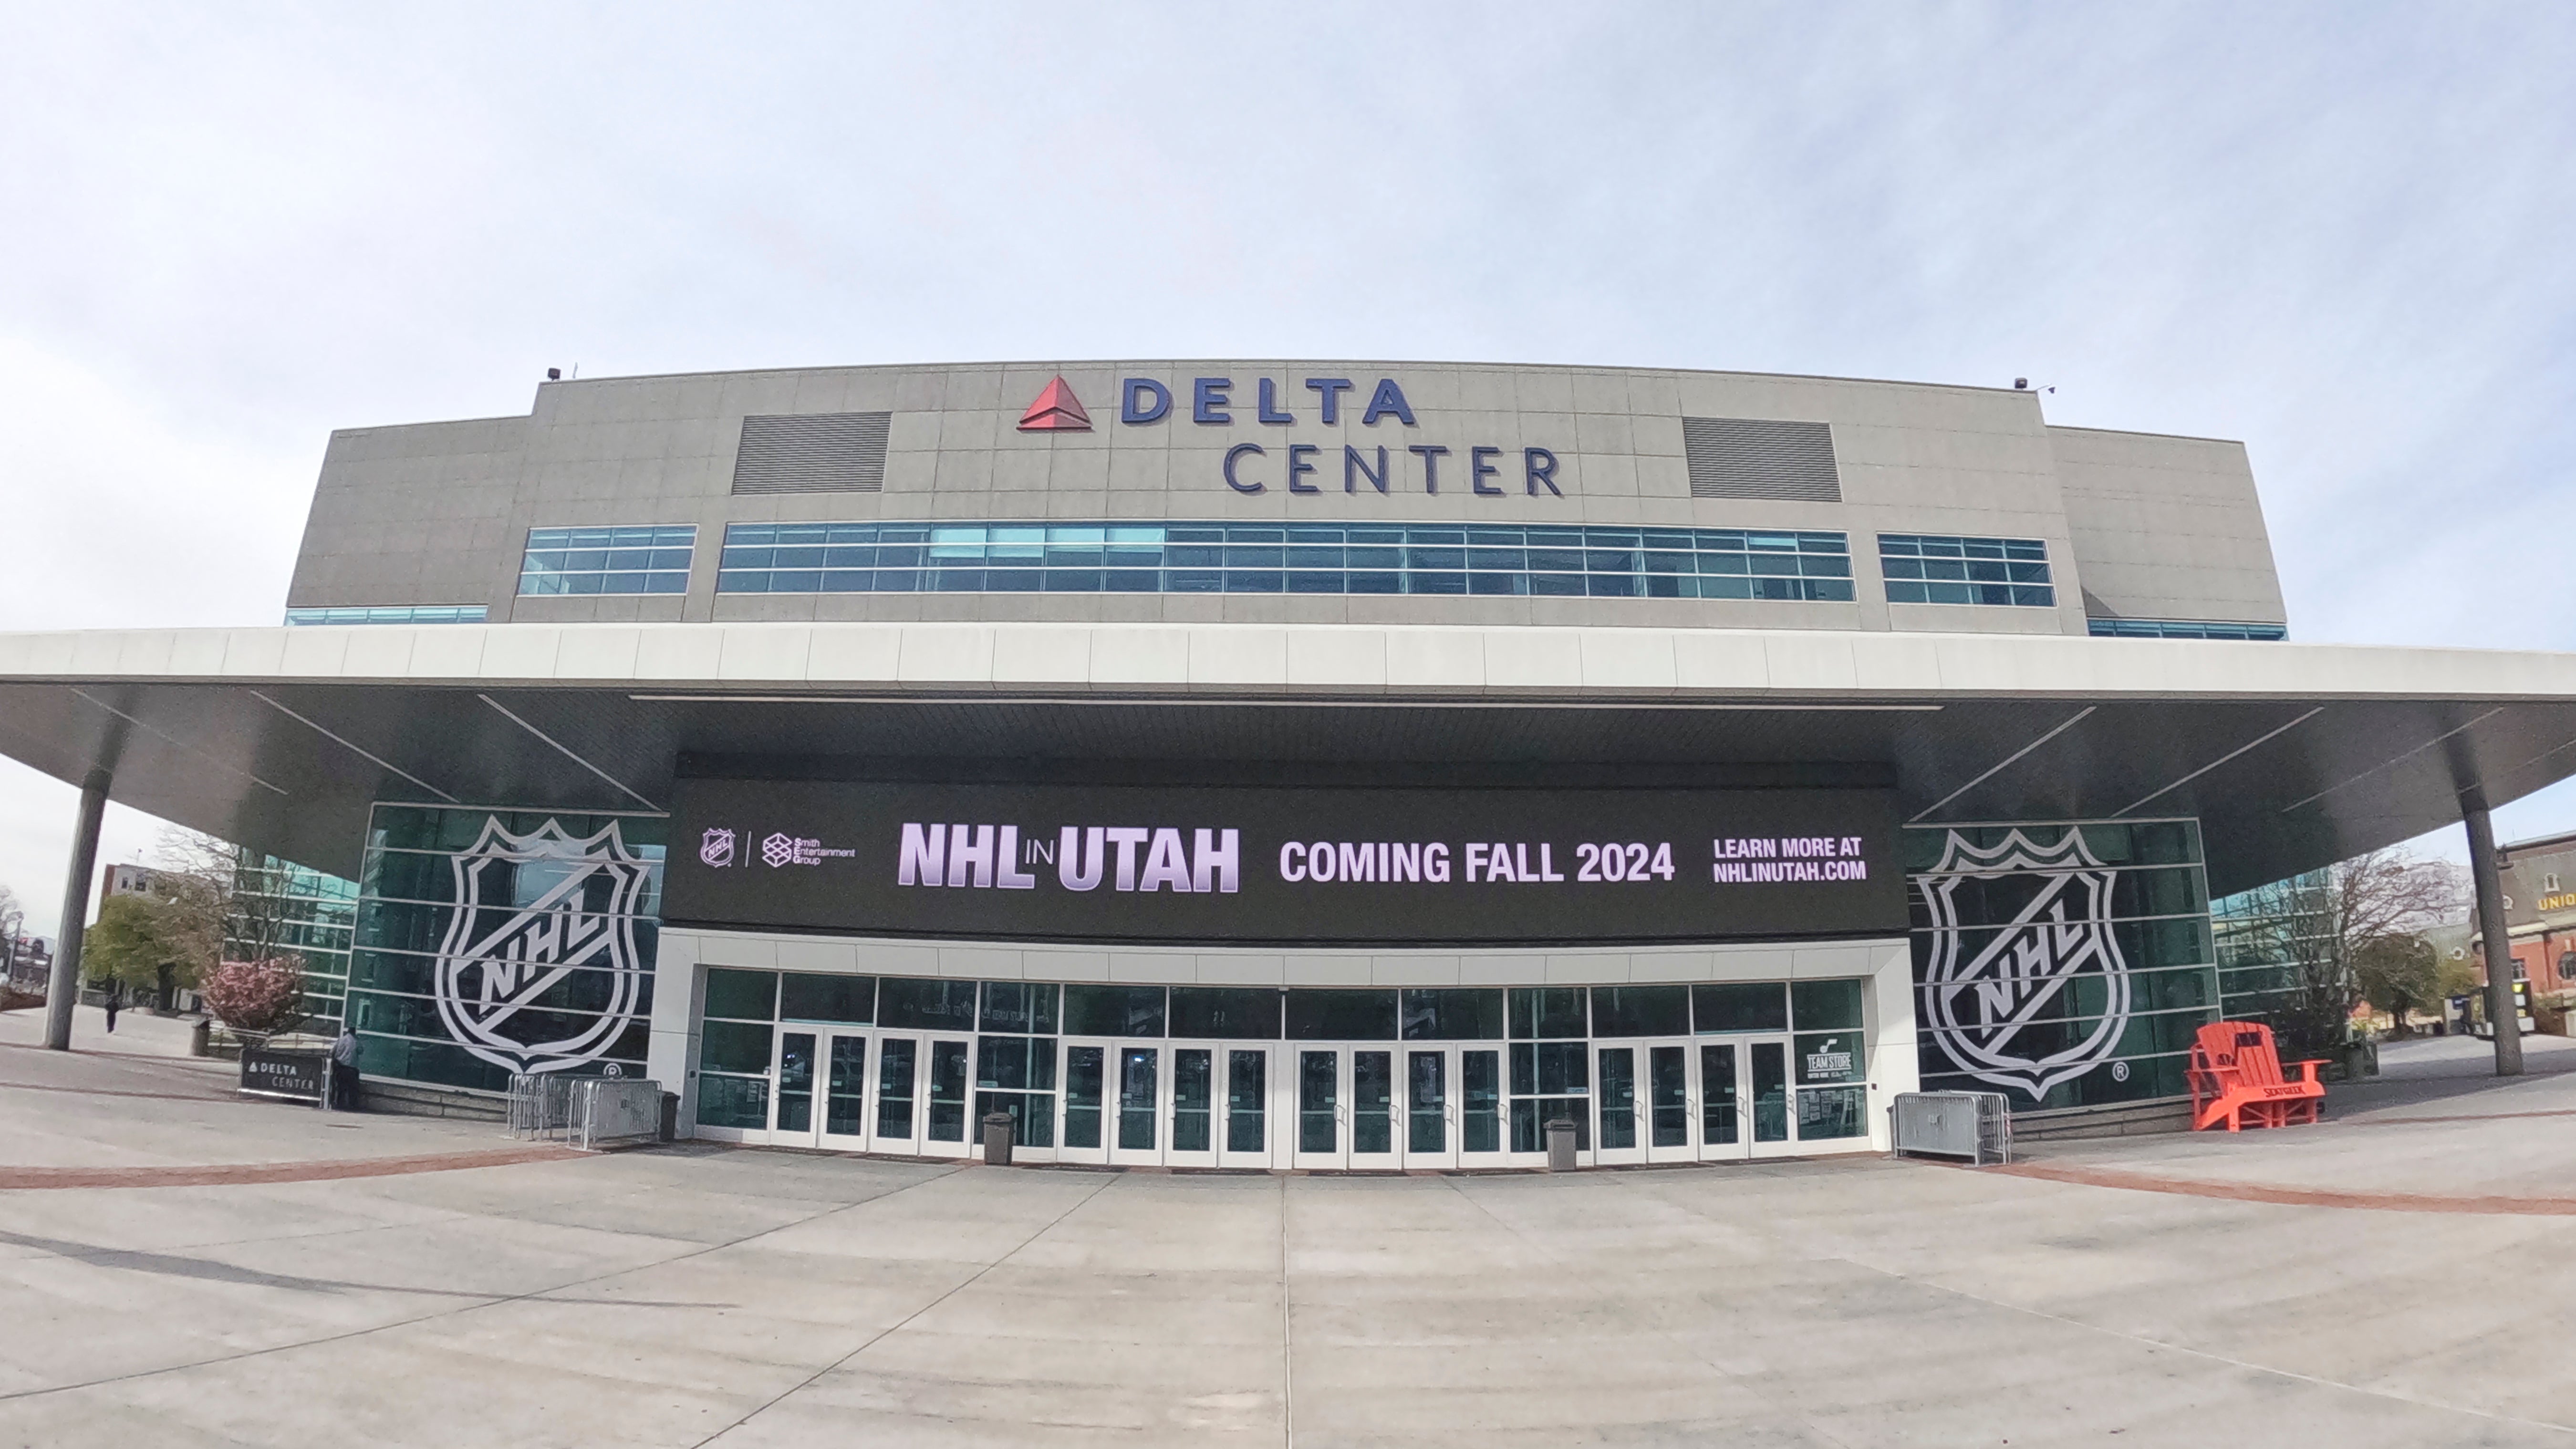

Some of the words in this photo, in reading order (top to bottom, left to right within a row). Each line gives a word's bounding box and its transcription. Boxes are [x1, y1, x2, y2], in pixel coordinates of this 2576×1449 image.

[1121, 377, 1415, 424] DELTA
[1223, 443, 1561, 495] CENTER
[708, 839, 727, 858] NHL
[793, 847, 855, 857] Entertainment
[794, 838, 820, 847] Smith
[1714, 839, 1776, 858] LEARN
[1782, 838, 1836, 857] MORE
[1840, 838, 1862, 856] AT
[792, 857, 821, 866] Group
[898, 823, 1035, 889] NHL
[1026, 839, 1053, 864] IN
[1059, 827, 1238, 893] UTAH
[1280, 842, 1450, 882] COMING
[1466, 843, 1564, 882] FALL
[1576, 843, 1675, 881] 2024
[1714, 860, 1866, 882] NHLINUTAH.COM
[479, 888, 600, 1015] NHL
[1974, 898, 2084, 1039] NHL
[261, 1063, 296, 1075] DELTA
[1807, 1056, 1828, 1069] TEAM
[1829, 1055, 1851, 1068] STORE
[271, 1076, 313, 1089] CENTER
